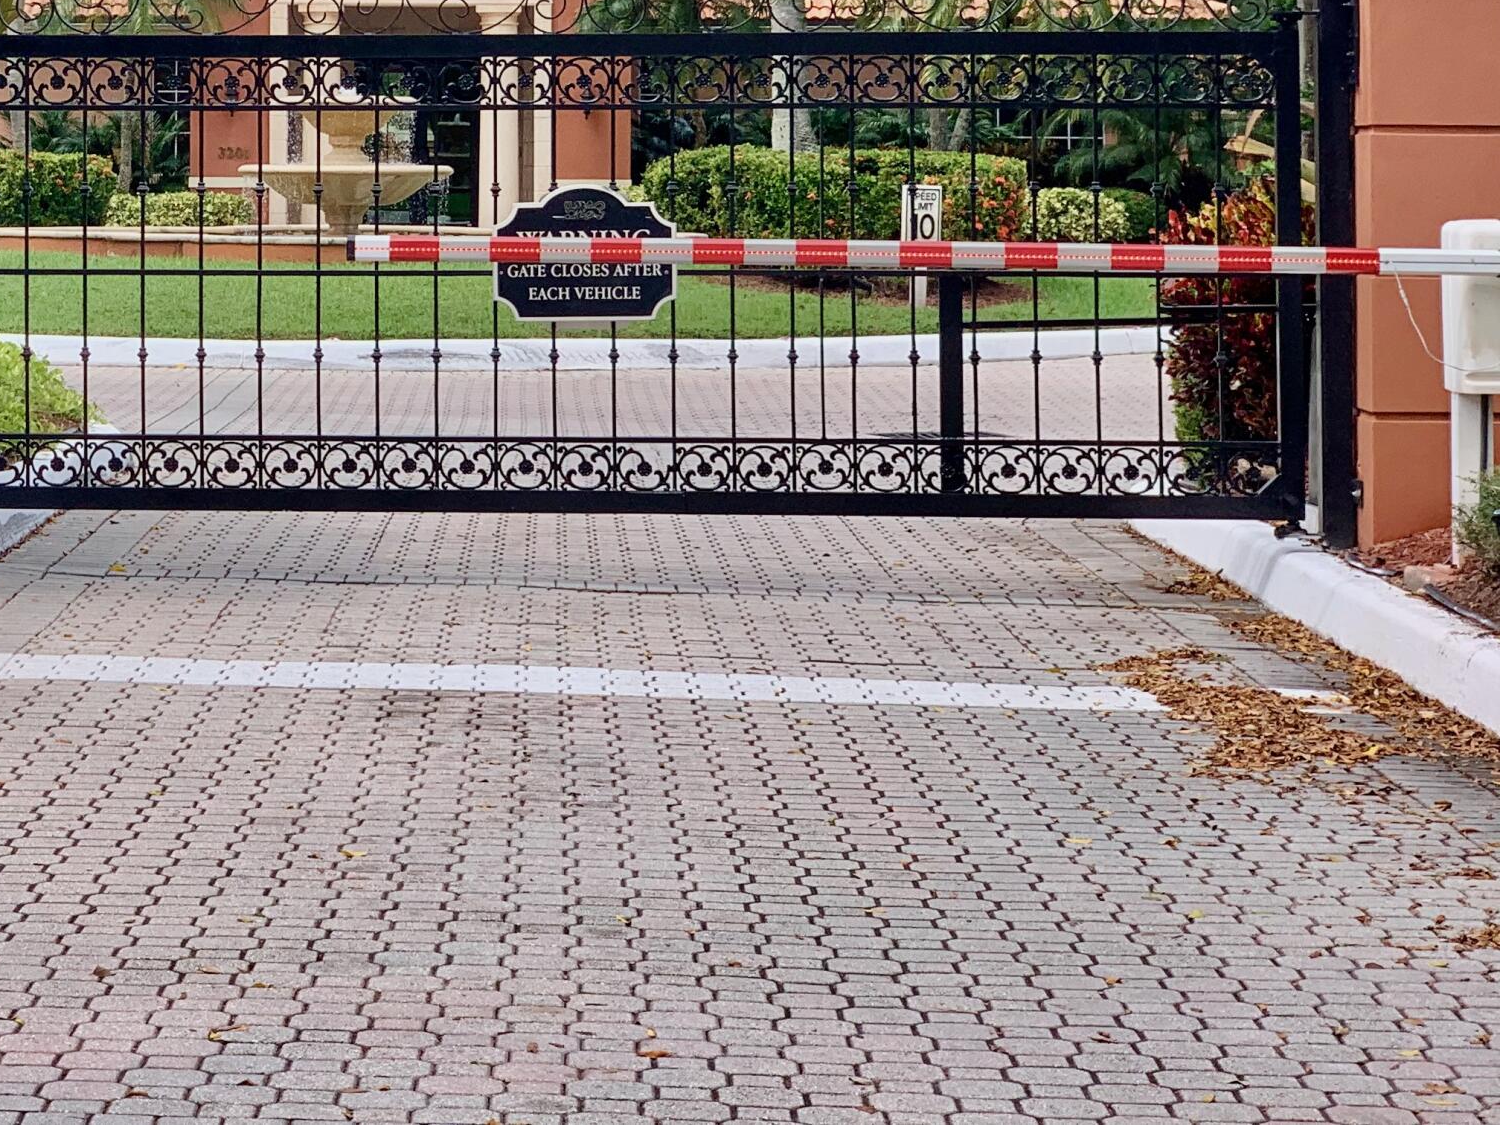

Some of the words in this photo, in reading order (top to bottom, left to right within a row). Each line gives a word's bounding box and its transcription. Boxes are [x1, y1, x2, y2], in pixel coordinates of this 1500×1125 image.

[911, 192, 937, 201] PEED
[913, 202, 934, 211] IMIT
[507, 264, 547, 277] GATE
[550, 263, 610, 277] CLOSES
[613, 263, 663, 276] AFTER
[528, 286, 571, 300] EACH
[573, 286, 641, 300] VEHICLE
